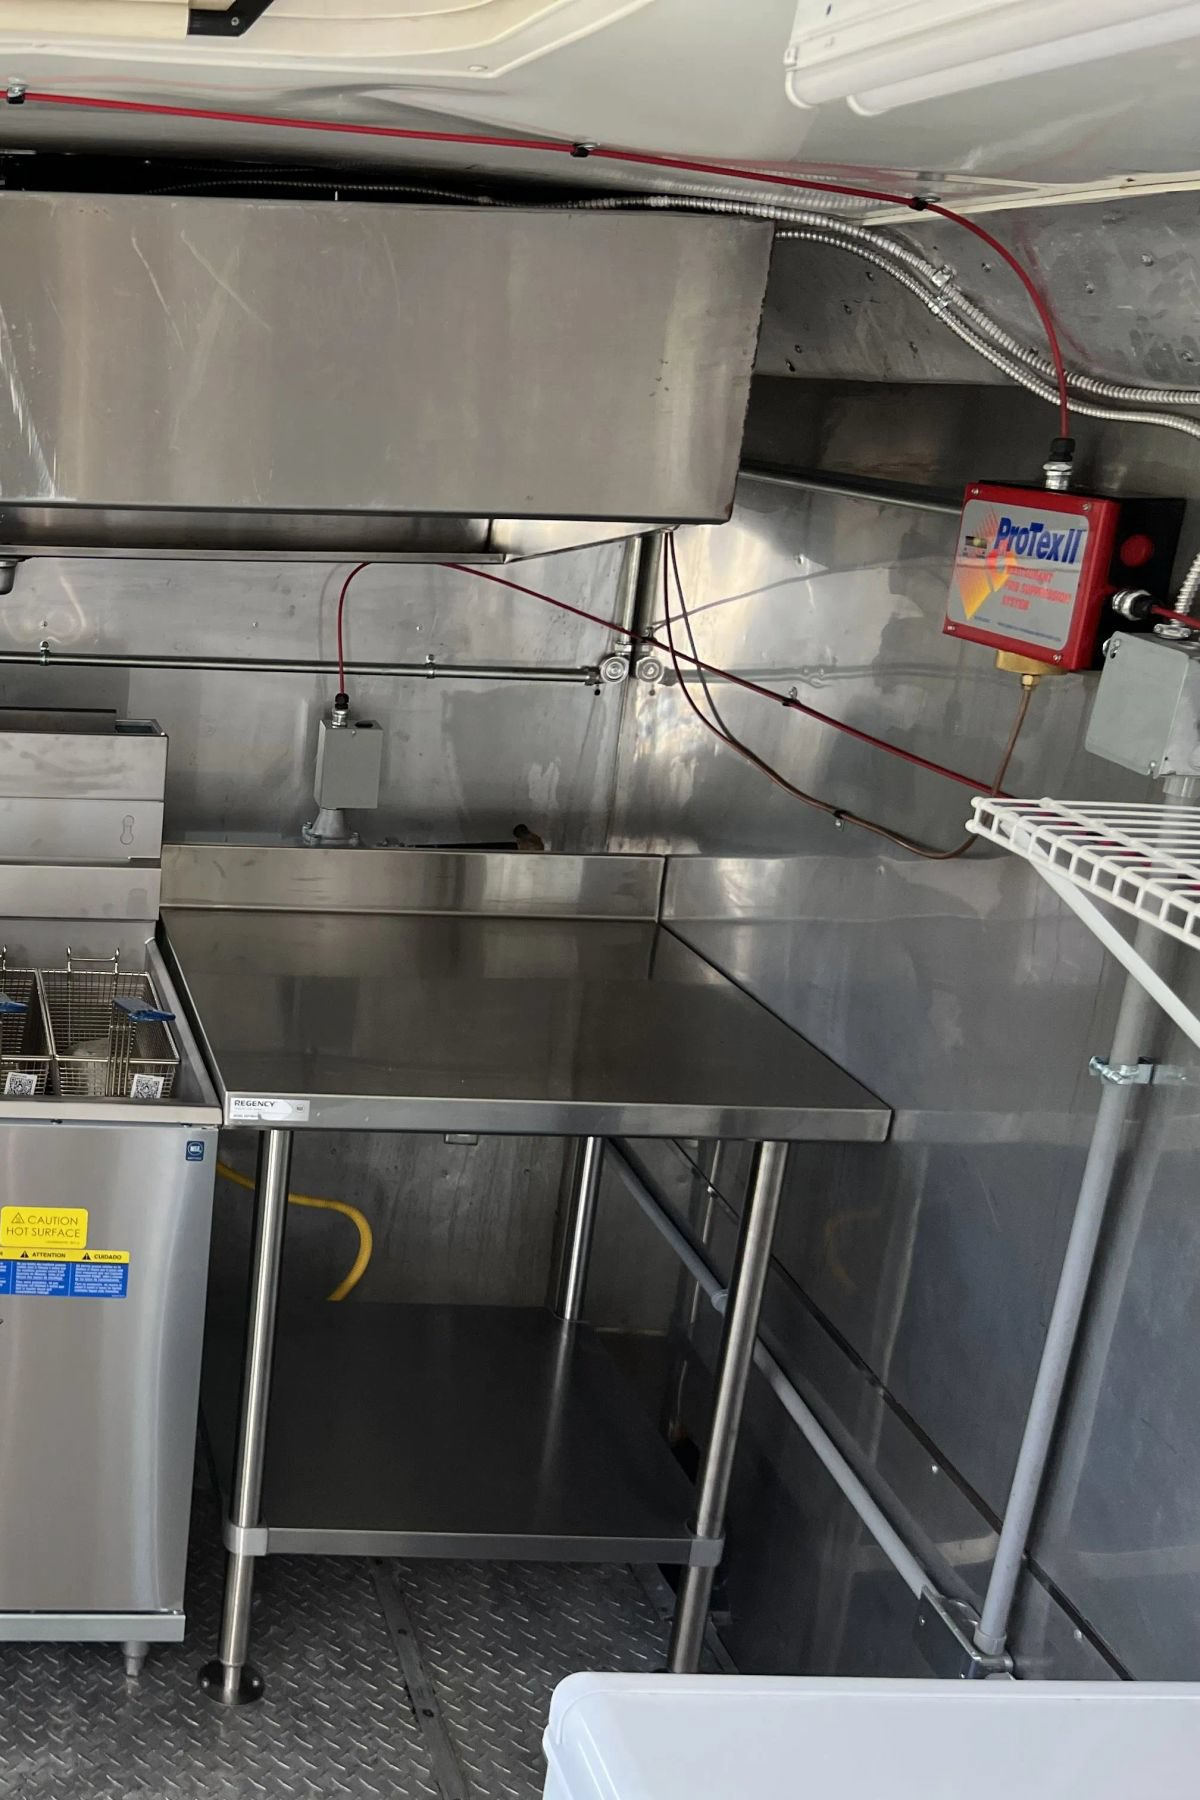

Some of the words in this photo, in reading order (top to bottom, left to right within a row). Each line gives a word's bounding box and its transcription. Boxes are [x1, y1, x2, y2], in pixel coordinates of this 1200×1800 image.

[234, 1099, 275, 1108] REGENCY
[27, 1215, 78, 1226] CAUTION
[6, 1226, 29, 1237] HOT
[31, 1227, 81, 1238] SURFACE
